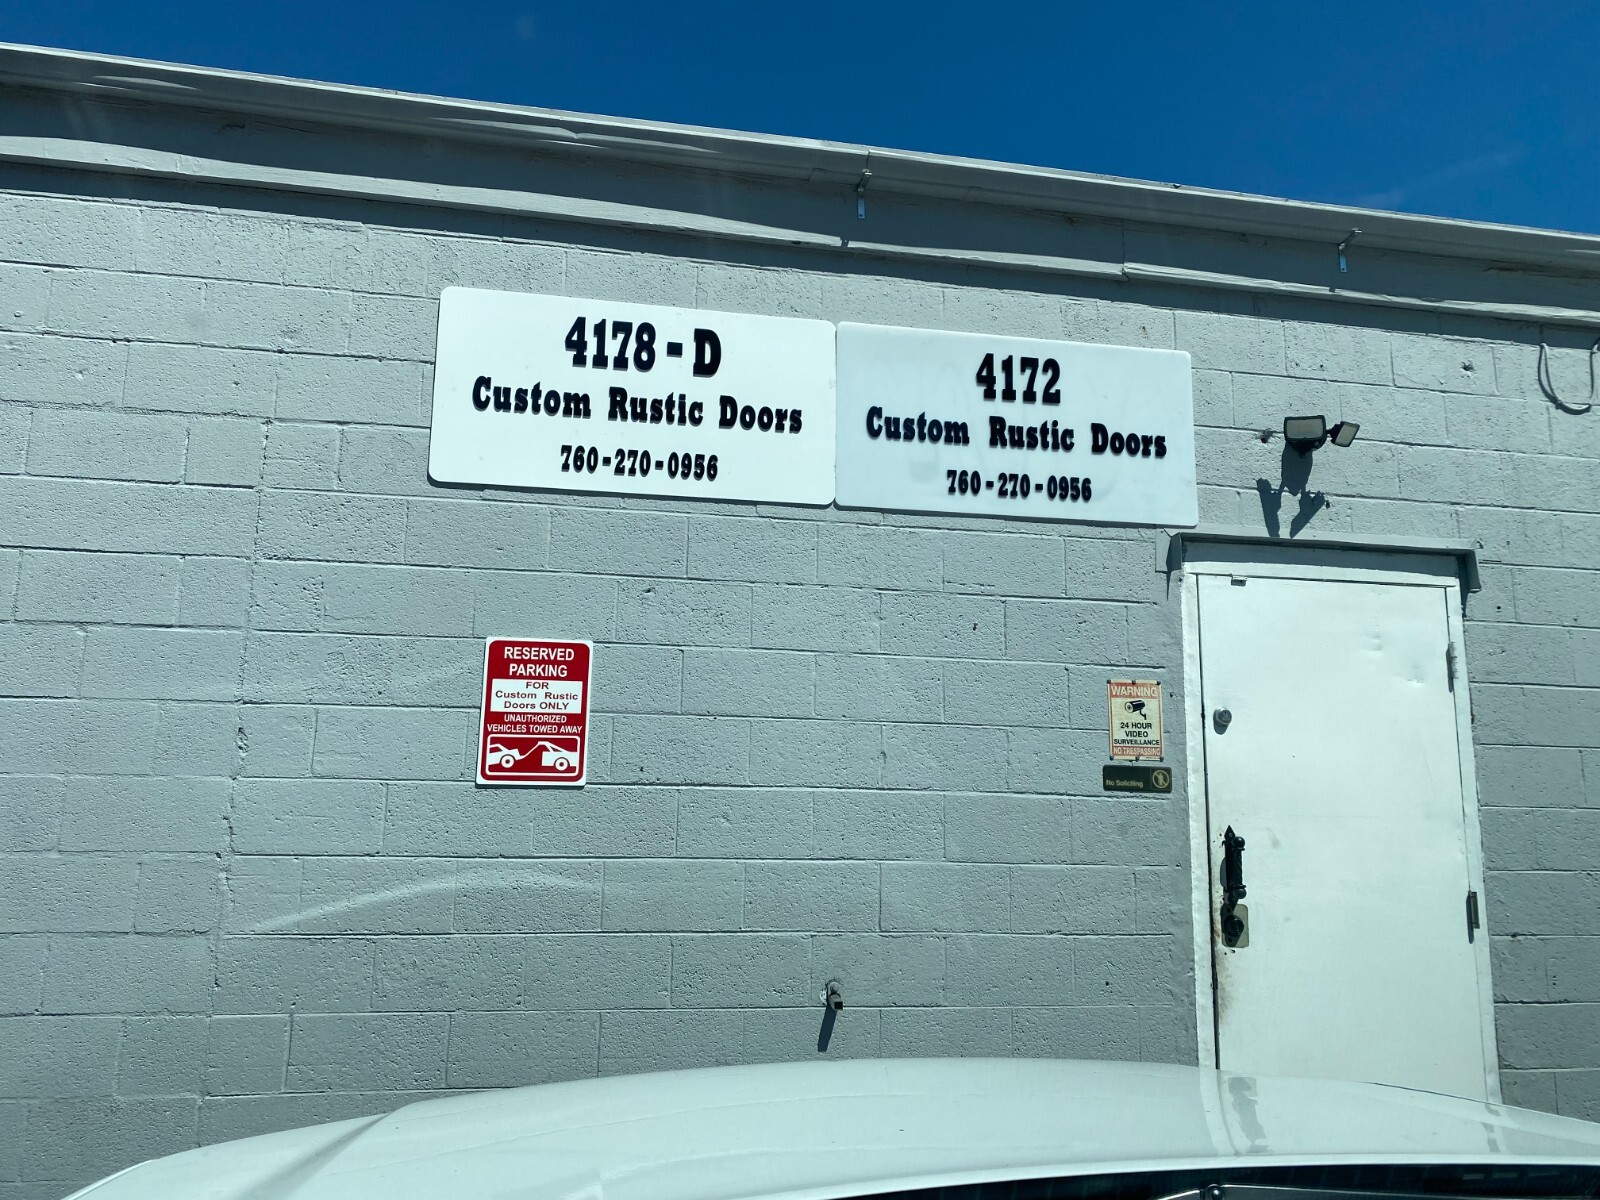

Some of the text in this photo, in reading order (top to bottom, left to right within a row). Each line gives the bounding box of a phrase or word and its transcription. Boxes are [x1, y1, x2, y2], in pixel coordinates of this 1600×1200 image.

[976, 353, 1061, 405] 4172
[472, 375, 803, 433] Custom Rustic Doors
[866, 406, 1167, 458] Custom Rustic Doors
[560, 445, 718, 481] 760-270-0956
[947, 469, 1092, 502] 760-270-0956
[504, 647, 574, 661] RESERVED
[509, 664, 567, 677] PARKING
[495, 691, 578, 700] Custom Rustic
[1111, 686, 1158, 697] WARNING
[504, 701, 569, 710] Doors ONLY
[504, 714, 567, 723] UNAUTHORIZED
[487, 724, 582, 734] VEHICLES TOWED AWAY
[1113, 747, 1160, 755] NO TRESPASSING
